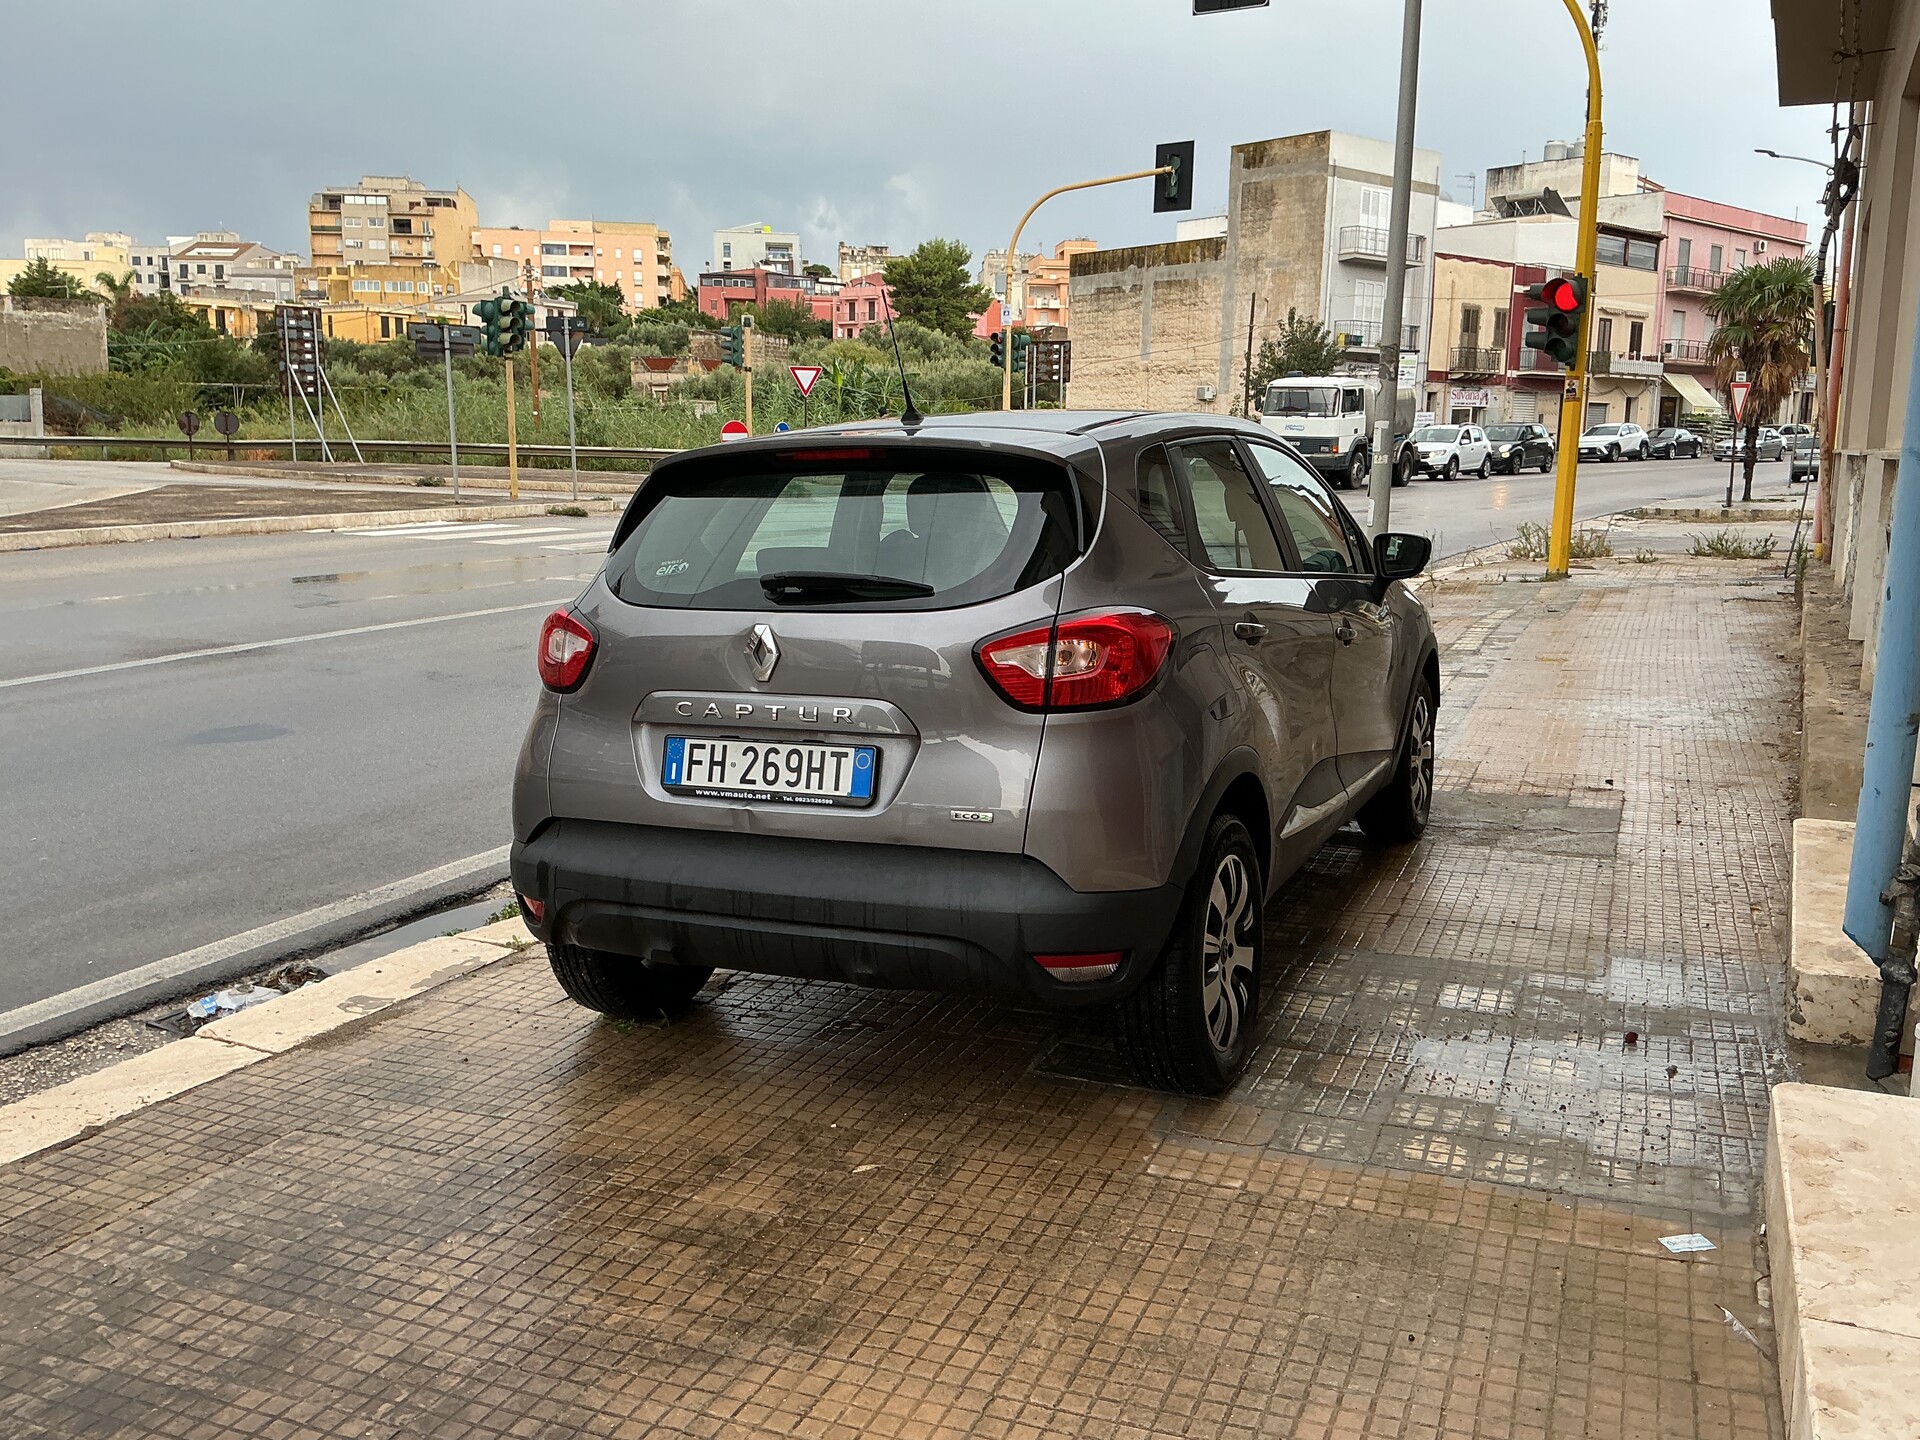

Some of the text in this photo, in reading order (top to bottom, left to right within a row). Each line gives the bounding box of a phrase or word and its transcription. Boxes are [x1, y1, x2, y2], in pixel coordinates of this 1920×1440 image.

[1451, 389, 1480, 400] Silvana
[656, 564, 678, 575] elf
[675, 701, 854, 724] CAPTUR
[686, 743, 849, 791] FH 269HT
[695, 789, 771, 800] www.vmauto.net
